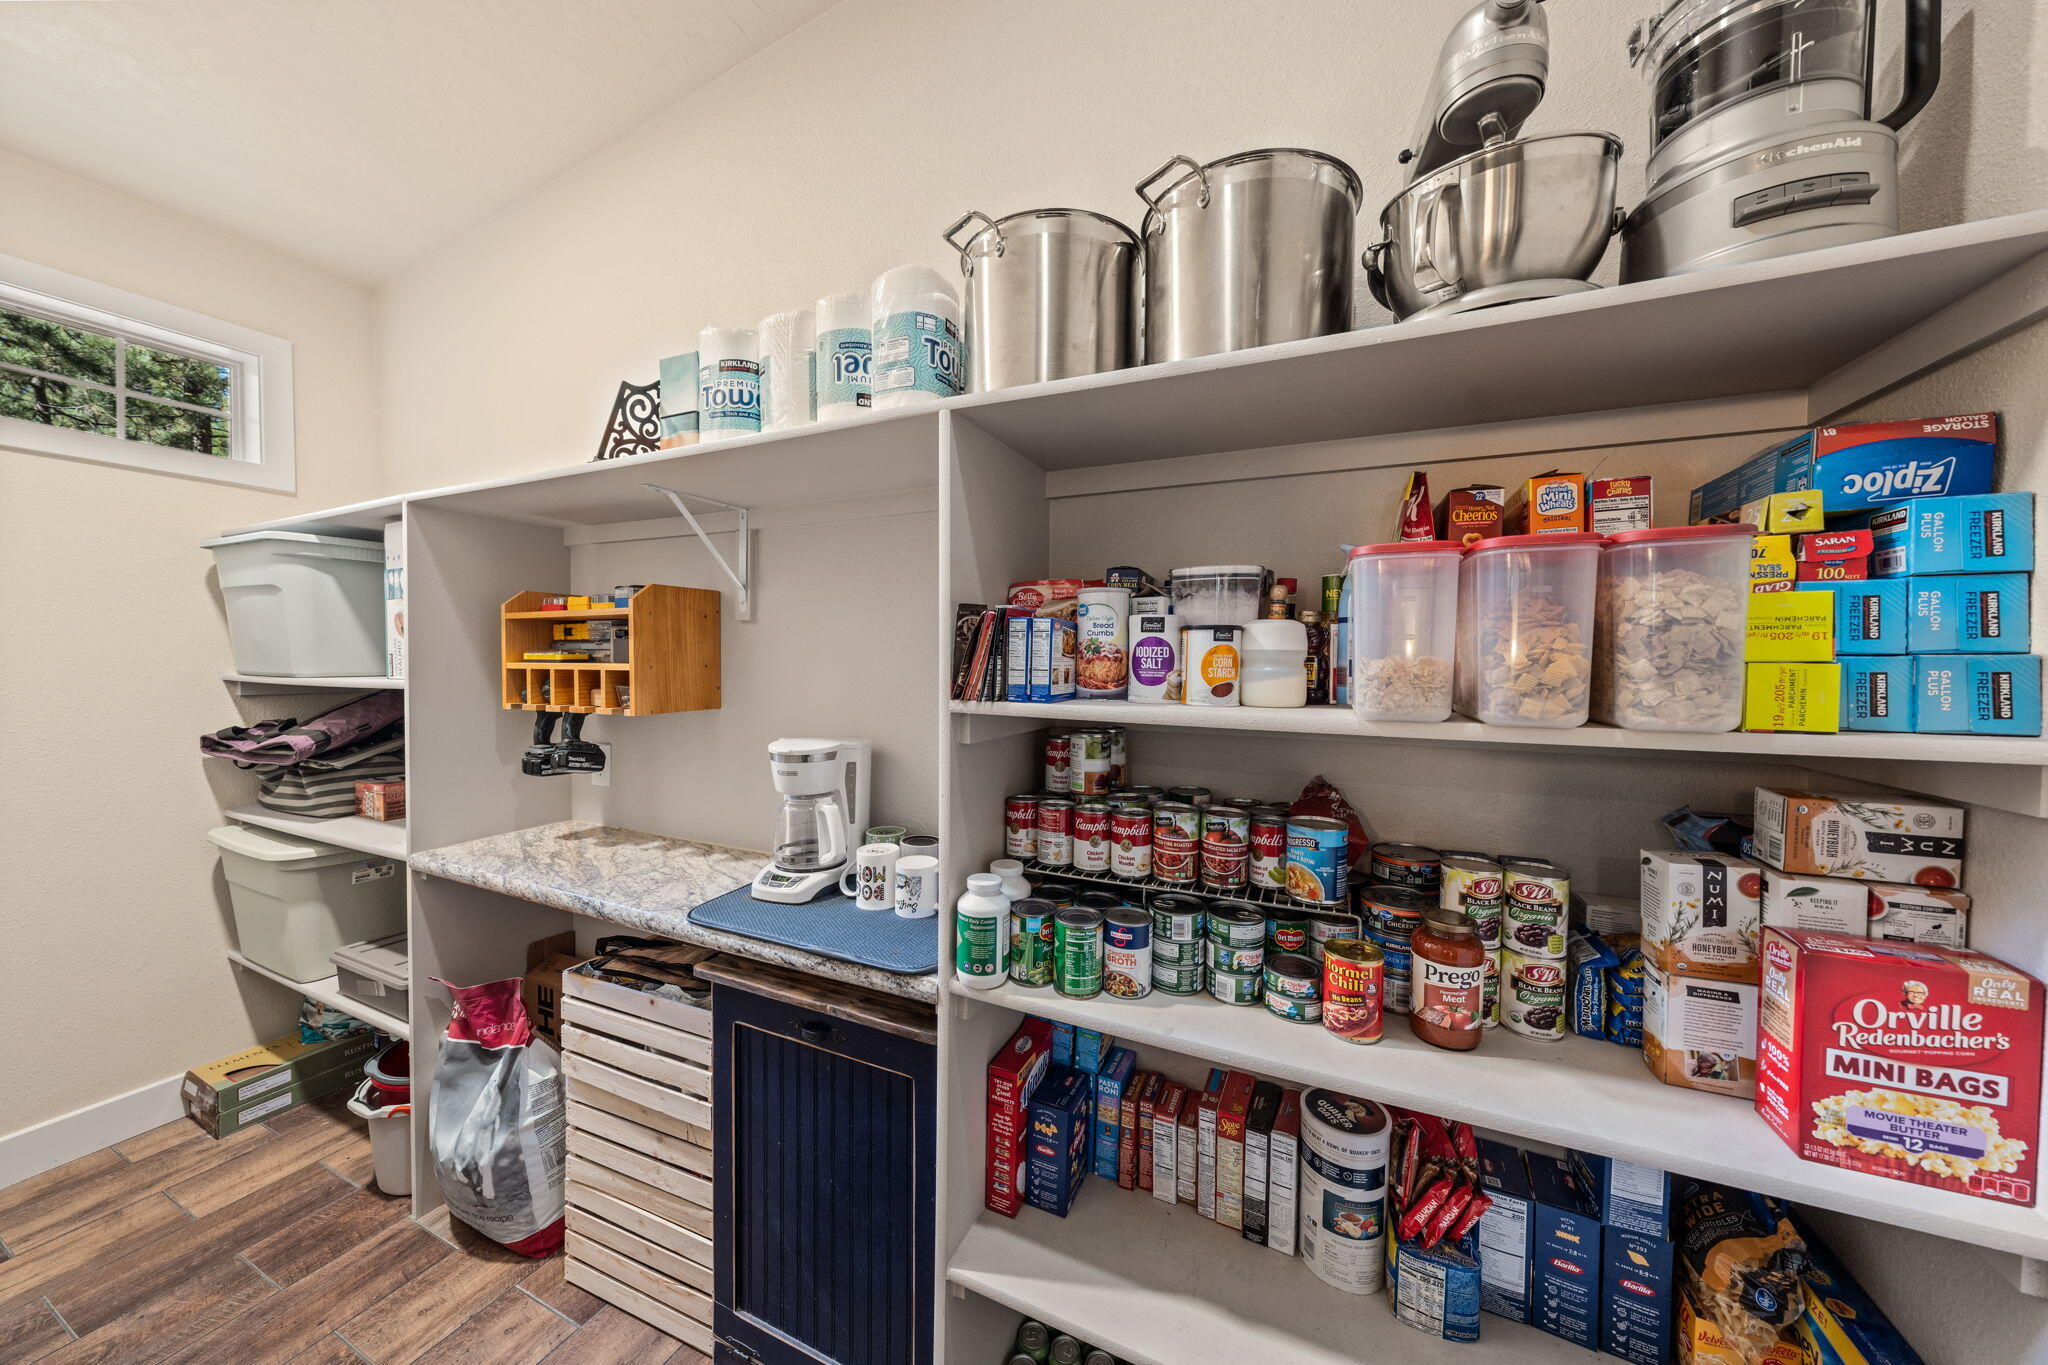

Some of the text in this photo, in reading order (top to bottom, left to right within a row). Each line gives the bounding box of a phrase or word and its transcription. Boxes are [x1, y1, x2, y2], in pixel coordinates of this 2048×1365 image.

[720, 360, 758, 370] KIRKLAND
[716, 380, 760, 390] PREMIU
[1945, 413, 1988, 423] GALLON
[1823, 428, 1837, 436] 81
[1922, 420, 1990, 433] STORAGE
[1843, 460, 1944, 497] Ziploc
[1452, 509, 1498, 522] Cheerios
[1871, 511, 1907, 527] KIRKLAND
[1921, 513, 1931, 538] PLUS
[1933, 512, 1945, 552] GALLON
[1992, 511, 2004, 555] KIRKLAND
[1815, 536, 1856, 546] SARAN
[1969, 511, 1982, 559] FREEZER
[1816, 567, 1845, 579] 100
[1754, 581, 1792, 593] GLAD
[1018, 592, 1038, 602] Betty
[1918, 591, 1928, 616] PLUS
[1849, 595, 1861, 641] FREEZER
[1869, 597, 1879, 639] KIRKLAND
[1930, 590, 1941, 631] GALLON
[1965, 591, 1978, 640] FREEZER
[1988, 593, 1998, 636] KIRKLAND
[1087, 629, 1114, 637] Crumbs
[1135, 646, 1170, 658] IODIZED
[1141, 658, 1163, 669] SALT
[1212, 657, 1233, 667] CORN
[1208, 668, 1235, 678] STARCH
[1788, 668, 1796, 708] PARCHMENT
[1928, 670, 1938, 695] PLUS
[1940, 669, 1952, 711] GALLON
[1856, 671, 1868, 719] FREEZER
[1877, 674, 1886, 716] KIRKLAND
[1976, 671, 1990, 721] FREEZER
[2000, 674, 2010, 718] KIRKLAND
[1799, 688, 1807, 727] PARCHEMIN
[1773, 715, 1784, 727] 19
[1827, 819, 1840, 858] HONEYBUSH
[1880, 838, 1956, 856] NUMI
[1467, 897, 1488, 905] BLACK
[1706, 871, 1723, 919] NUMI
[1810, 898, 1833, 906] KEEPING
[1509, 899, 1557, 913] BLACK BEANS
[1510, 907, 1554, 922] Organic
[1386, 920, 1414, 929] CHICKEN
[1108, 949, 1135, 958] CHICKEN
[1692, 943, 1737, 955] HONEYBUSH
[1107, 954, 1137, 966] BROTH
[1325, 955, 1373, 980] Hormel
[1329, 972, 1364, 992] Chili
[1424, 963, 1480, 990] Prego
[1769, 967, 1786, 985] Only
[1981, 977, 2017, 991] Only
[1518, 981, 1564, 994] BLACK BEANS
[1766, 976, 1790, 1002] REAL
[1973, 986, 2025, 1002] REAL
[1331, 993, 1363, 1003] No Beans
[1442, 995, 1466, 1004] Meat
[1519, 992, 1561, 1002] Organic
[1692, 991, 1733, 1001] DIFFERENCE
[1973, 997, 2026, 1008] INGREDIENTS
[1580, 984, 1591, 1026] Maruchan
[1852, 998, 1983, 1032] Orville
[1832, 1021, 2010, 1050] Redenbacher's
[1767, 1041, 1790, 1067] 100%
[1098, 1078, 1119, 1089] PASTA
[1833, 1054, 2000, 1099] MINI BAGS
[1098, 1085, 1119, 1096] RONI
[1317, 1099, 1353, 1129] QUAKER
[1317, 1106, 1340, 1124] OATS
[1218, 1118, 1241, 1131] Stove
[1864, 1110, 1968, 1137] MOVIE THEATER
[1889, 1123, 1940, 1140] BUTTER
[1226, 1128, 1238, 1136] Top
[1326, 1141, 1341, 1151] BOWL
[1882, 1134, 1949, 1152] MINI 12 BAGS
[1508, 1198, 1526, 1207] Facts
[1414, 1199, 1439, 1224] IDAHOAN
[1686, 1202, 1726, 1228] WIDE
[1699, 1214, 1739, 1230] NOODLES
[1553, 1259, 1580, 1273] Barilla
[1623, 1280, 1652, 1295] Barilla
